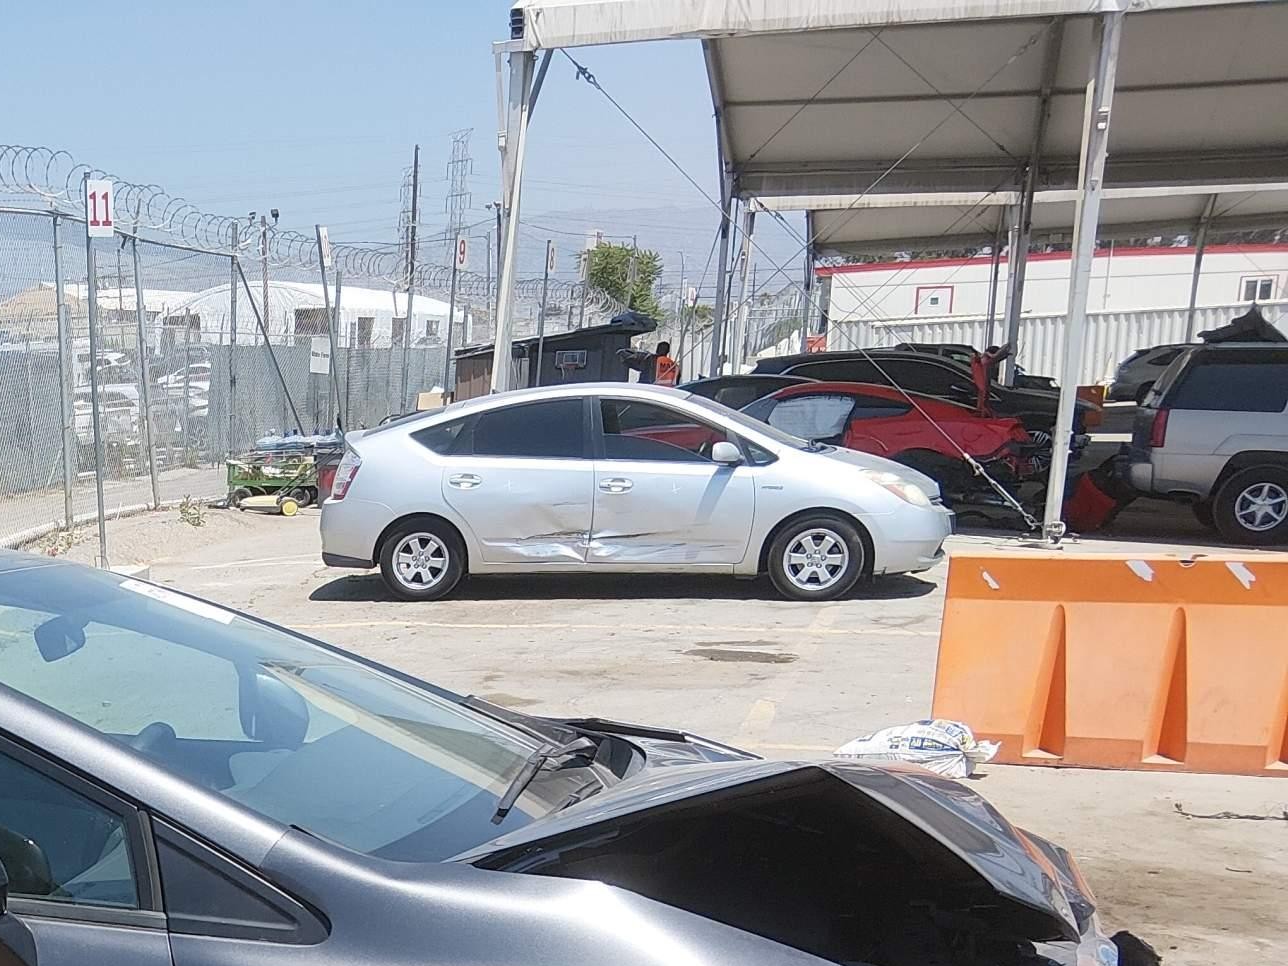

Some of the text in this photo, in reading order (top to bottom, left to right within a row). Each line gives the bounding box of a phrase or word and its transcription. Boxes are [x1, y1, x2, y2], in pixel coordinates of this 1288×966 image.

[89, 191, 112, 226] 11
[459, 239, 467, 264] 9
[549, 247, 555, 270] 8
